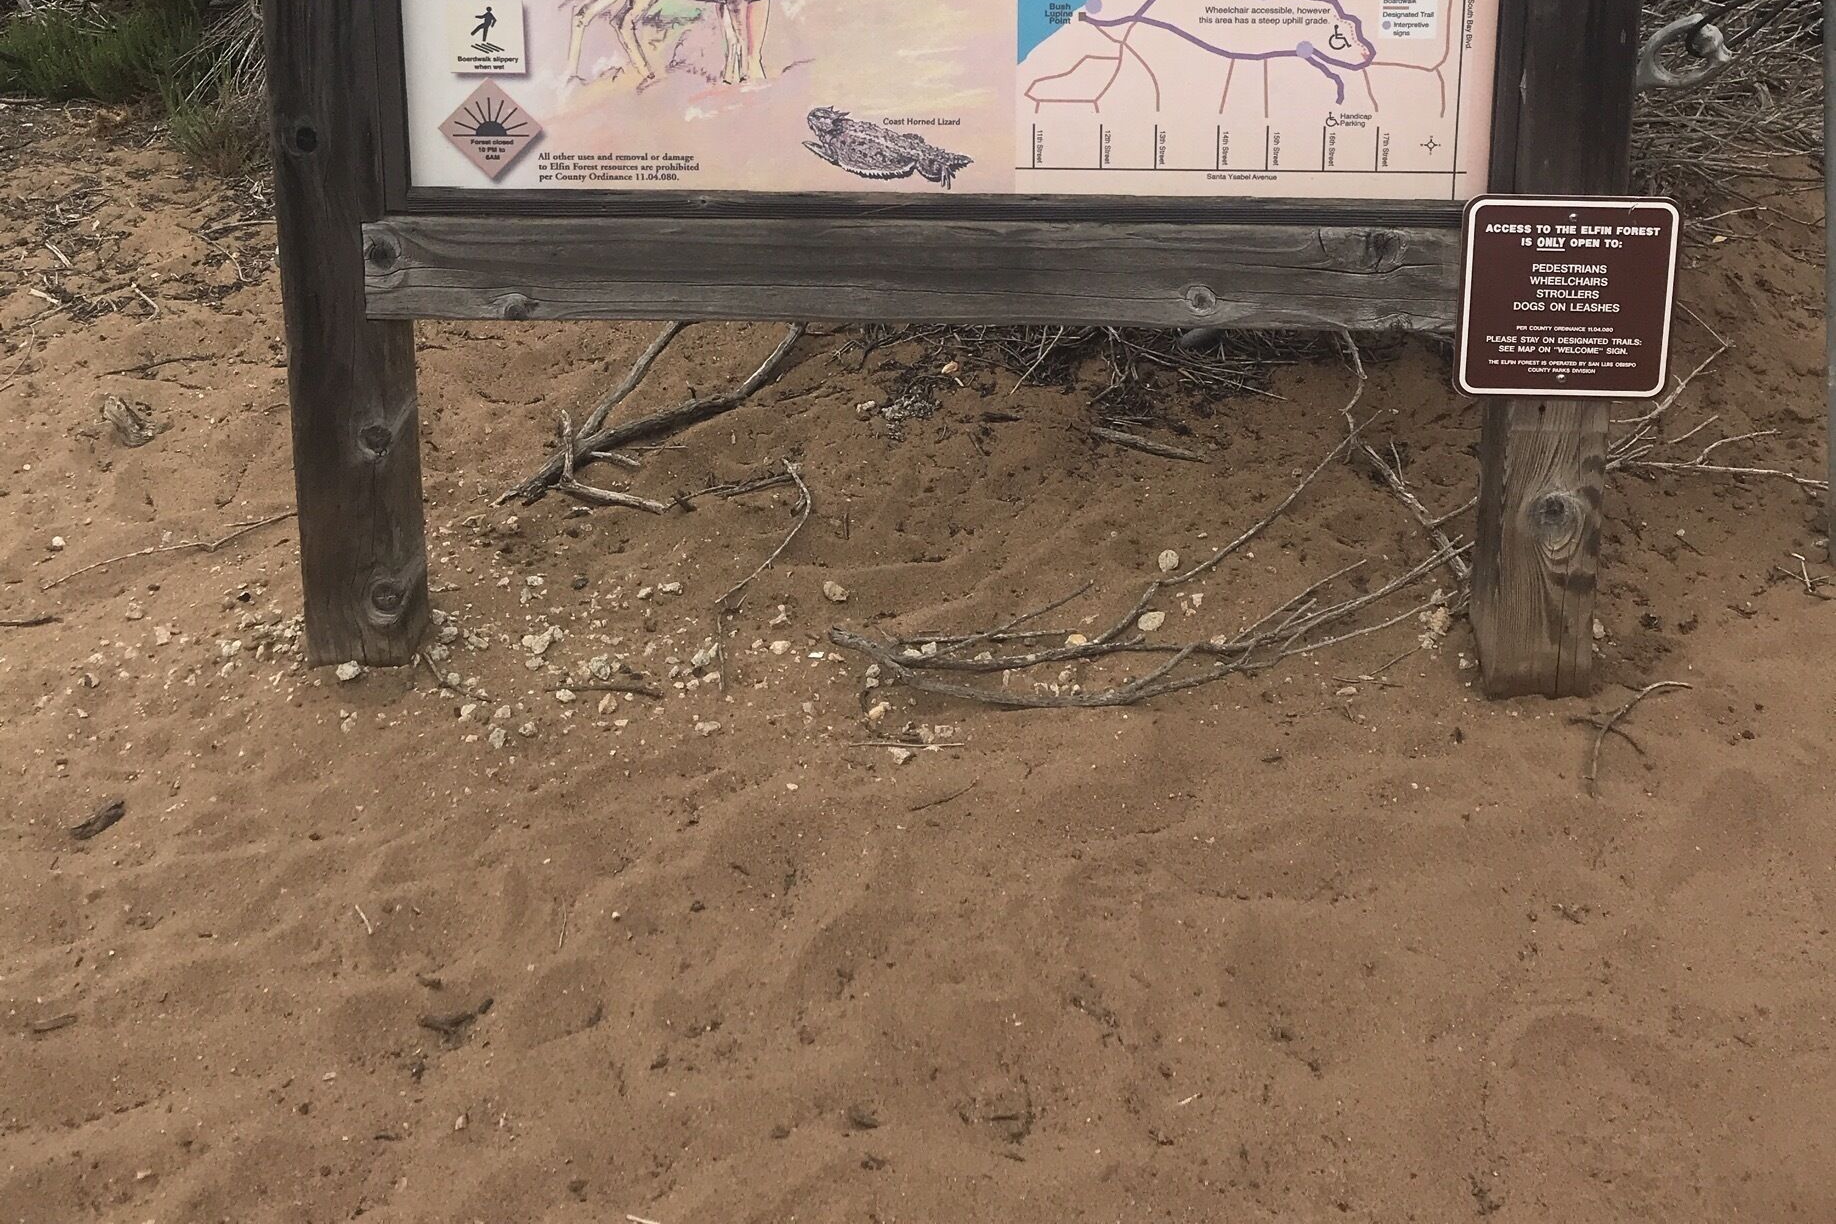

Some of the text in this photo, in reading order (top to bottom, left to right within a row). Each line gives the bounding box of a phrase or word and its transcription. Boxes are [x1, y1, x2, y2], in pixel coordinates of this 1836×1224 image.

[1044, 10, 1073, 18] Lupine
[1467, 0, 1475, 18] South
[1382, 11, 1418, 19] Designated
[1465, 20, 1474, 33] Bay
[883, 118, 961, 126] Coast Horned Lizard
[538, 153, 550, 161] All
[553, 153, 575, 161] other
[597, 153, 613, 161] and
[616, 153, 648, 161] removal
[662, 153, 694, 163] damage
[550, 163, 570, 171] Elfin
[573, 163, 598, 171] Forest
[655, 163, 699, 173] prohibited
[539, 173, 679, 183] per County Ordinance 11.04.080.
[1485, 224, 1661, 236] ACCESS TO THE ELFIN FOREST
[1521, 237, 1623, 249] IS ONLY OPEN TO:
[1532, 263, 1607, 274] PEDESTRIANS
[1530, 276, 1608, 287] WHEELCHAIRS
[1536, 289, 1600, 299] STROLLERS
[1513, 301, 1620, 313] DOGS ON LEASHES
[1486, 335, 1517, 343] PLEASE
[1542, 336, 1555, 344] ON
[1557, 337, 1609, 345] DESIGNATED
[1611, 338, 1642, 346] TRAILS:
[1498, 345, 1515, 353] SEE
[1517, 345, 1536, 353] MAP
[1553, 346, 1603, 354] "WELCOME"
[1606, 347, 1628, 355] SIGN.
